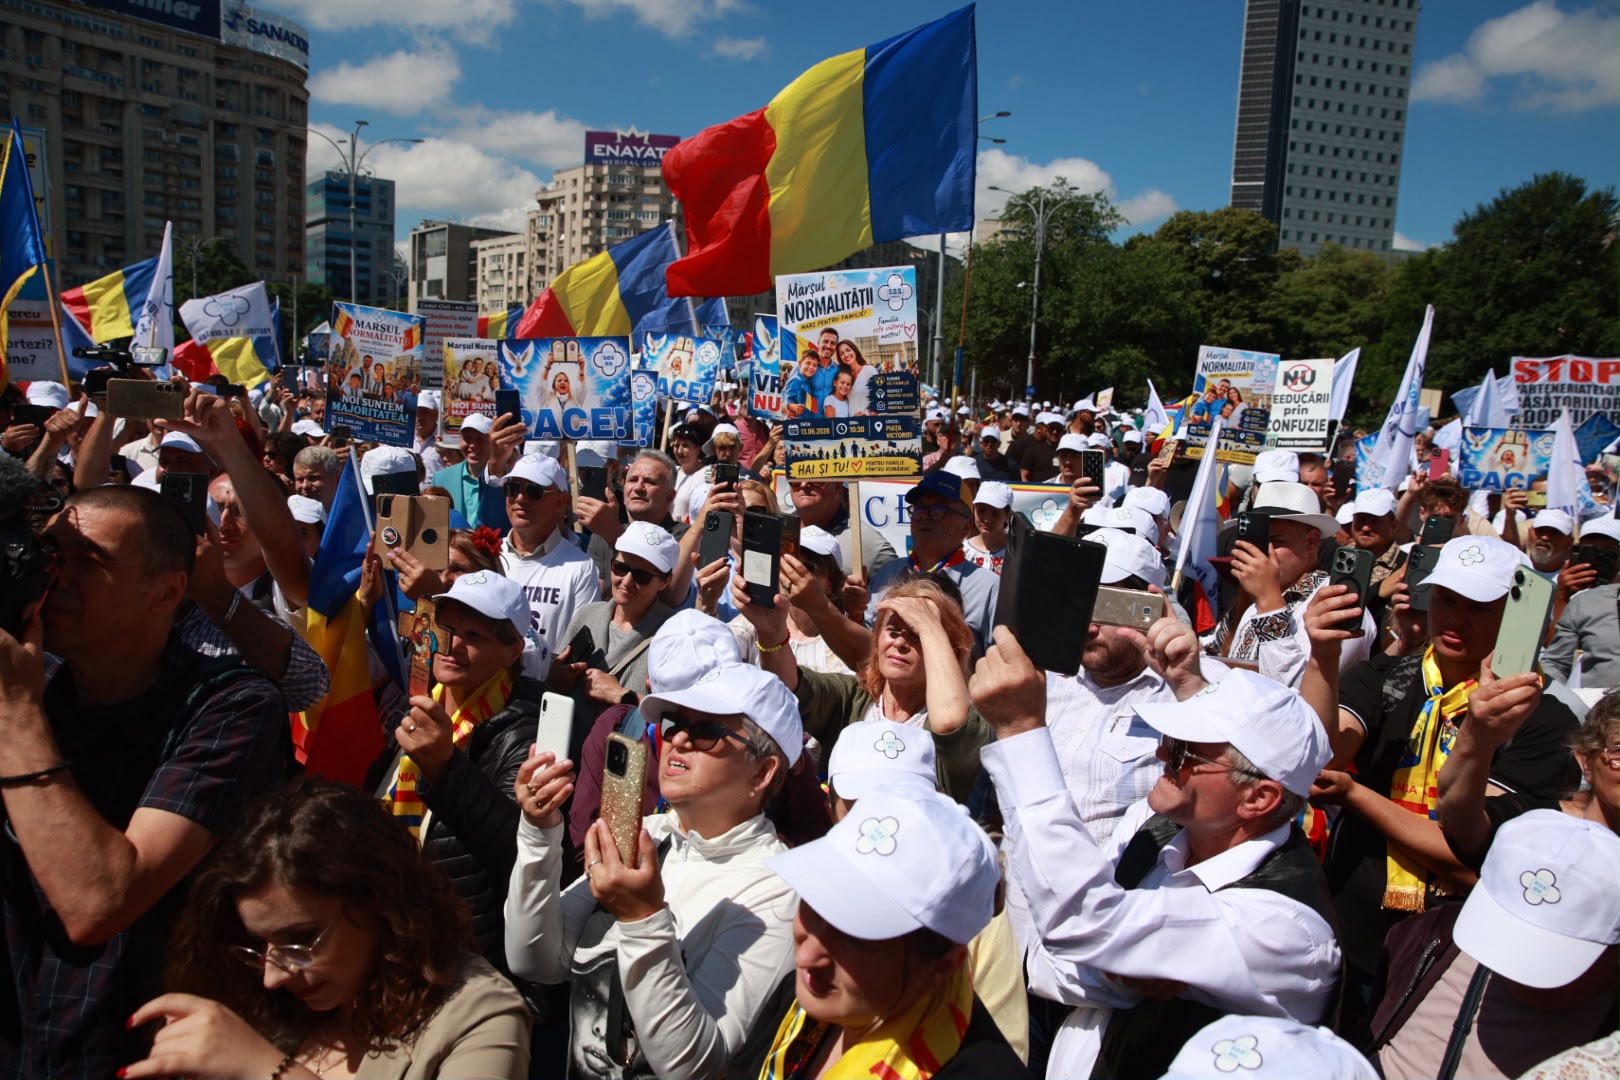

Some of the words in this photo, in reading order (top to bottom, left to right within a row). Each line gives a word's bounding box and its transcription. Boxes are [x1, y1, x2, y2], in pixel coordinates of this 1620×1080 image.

[246, 18, 310, 55] SANADOR
[593, 143, 672, 159] ENAYAT
[602, 159, 638, 167] MEDICAL
[787, 276, 826, 301] Marșul
[784, 286, 875, 326] NORMALITĂȚII
[354, 319, 401, 336] MARȘUL
[7, 339, 53, 350] ortezi?
[447, 342, 474, 350] Marșul
[1283, 370, 1316, 386] NU
[1514, 359, 1620, 385] STOP
[657, 376, 711, 403] ACE!
[1273, 391, 1330, 404] EEDUCĂRII
[331, 401, 410, 424] MAJORITATEA!
[341, 395, 361, 406] NOI
[361, 397, 405, 413] SUNTEM
[1283, 404, 1309, 417] prin
[798, 464, 815, 476] HAI
[818, 463, 829, 476] ȘI
[833, 460, 850, 473] TU!
[523, 585, 561, 605] TATE
